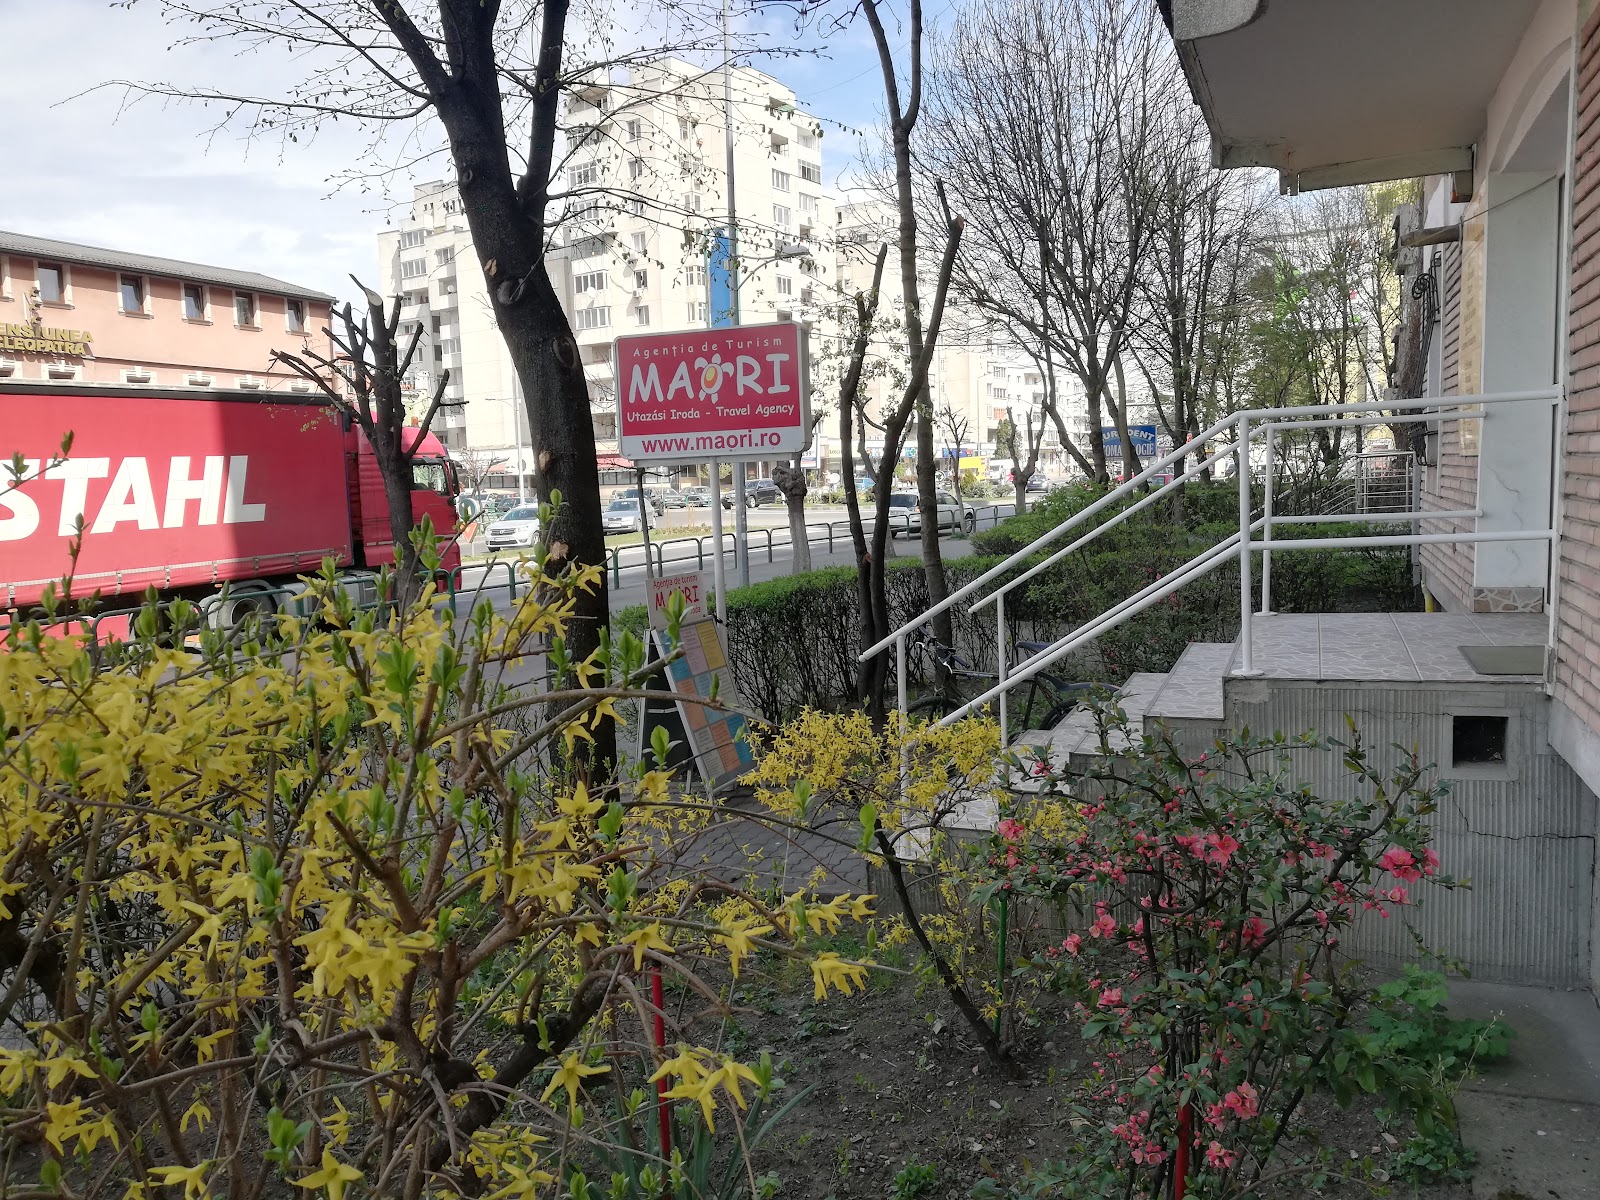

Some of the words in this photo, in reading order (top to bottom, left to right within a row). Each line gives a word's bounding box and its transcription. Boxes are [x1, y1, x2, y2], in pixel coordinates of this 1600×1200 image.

[701, 341, 718, 352] de
[725, 338, 782, 349] Turism
[628, 353, 790, 404] MAORI
[627, 409, 666, 422] Utazási
[670, 407, 700, 420] Iroda
[715, 403, 750, 417] Travel
[755, 403, 795, 417] Agency
[641, 430, 781, 453] www.maori.ro
[655, 585, 700, 611] MRI
